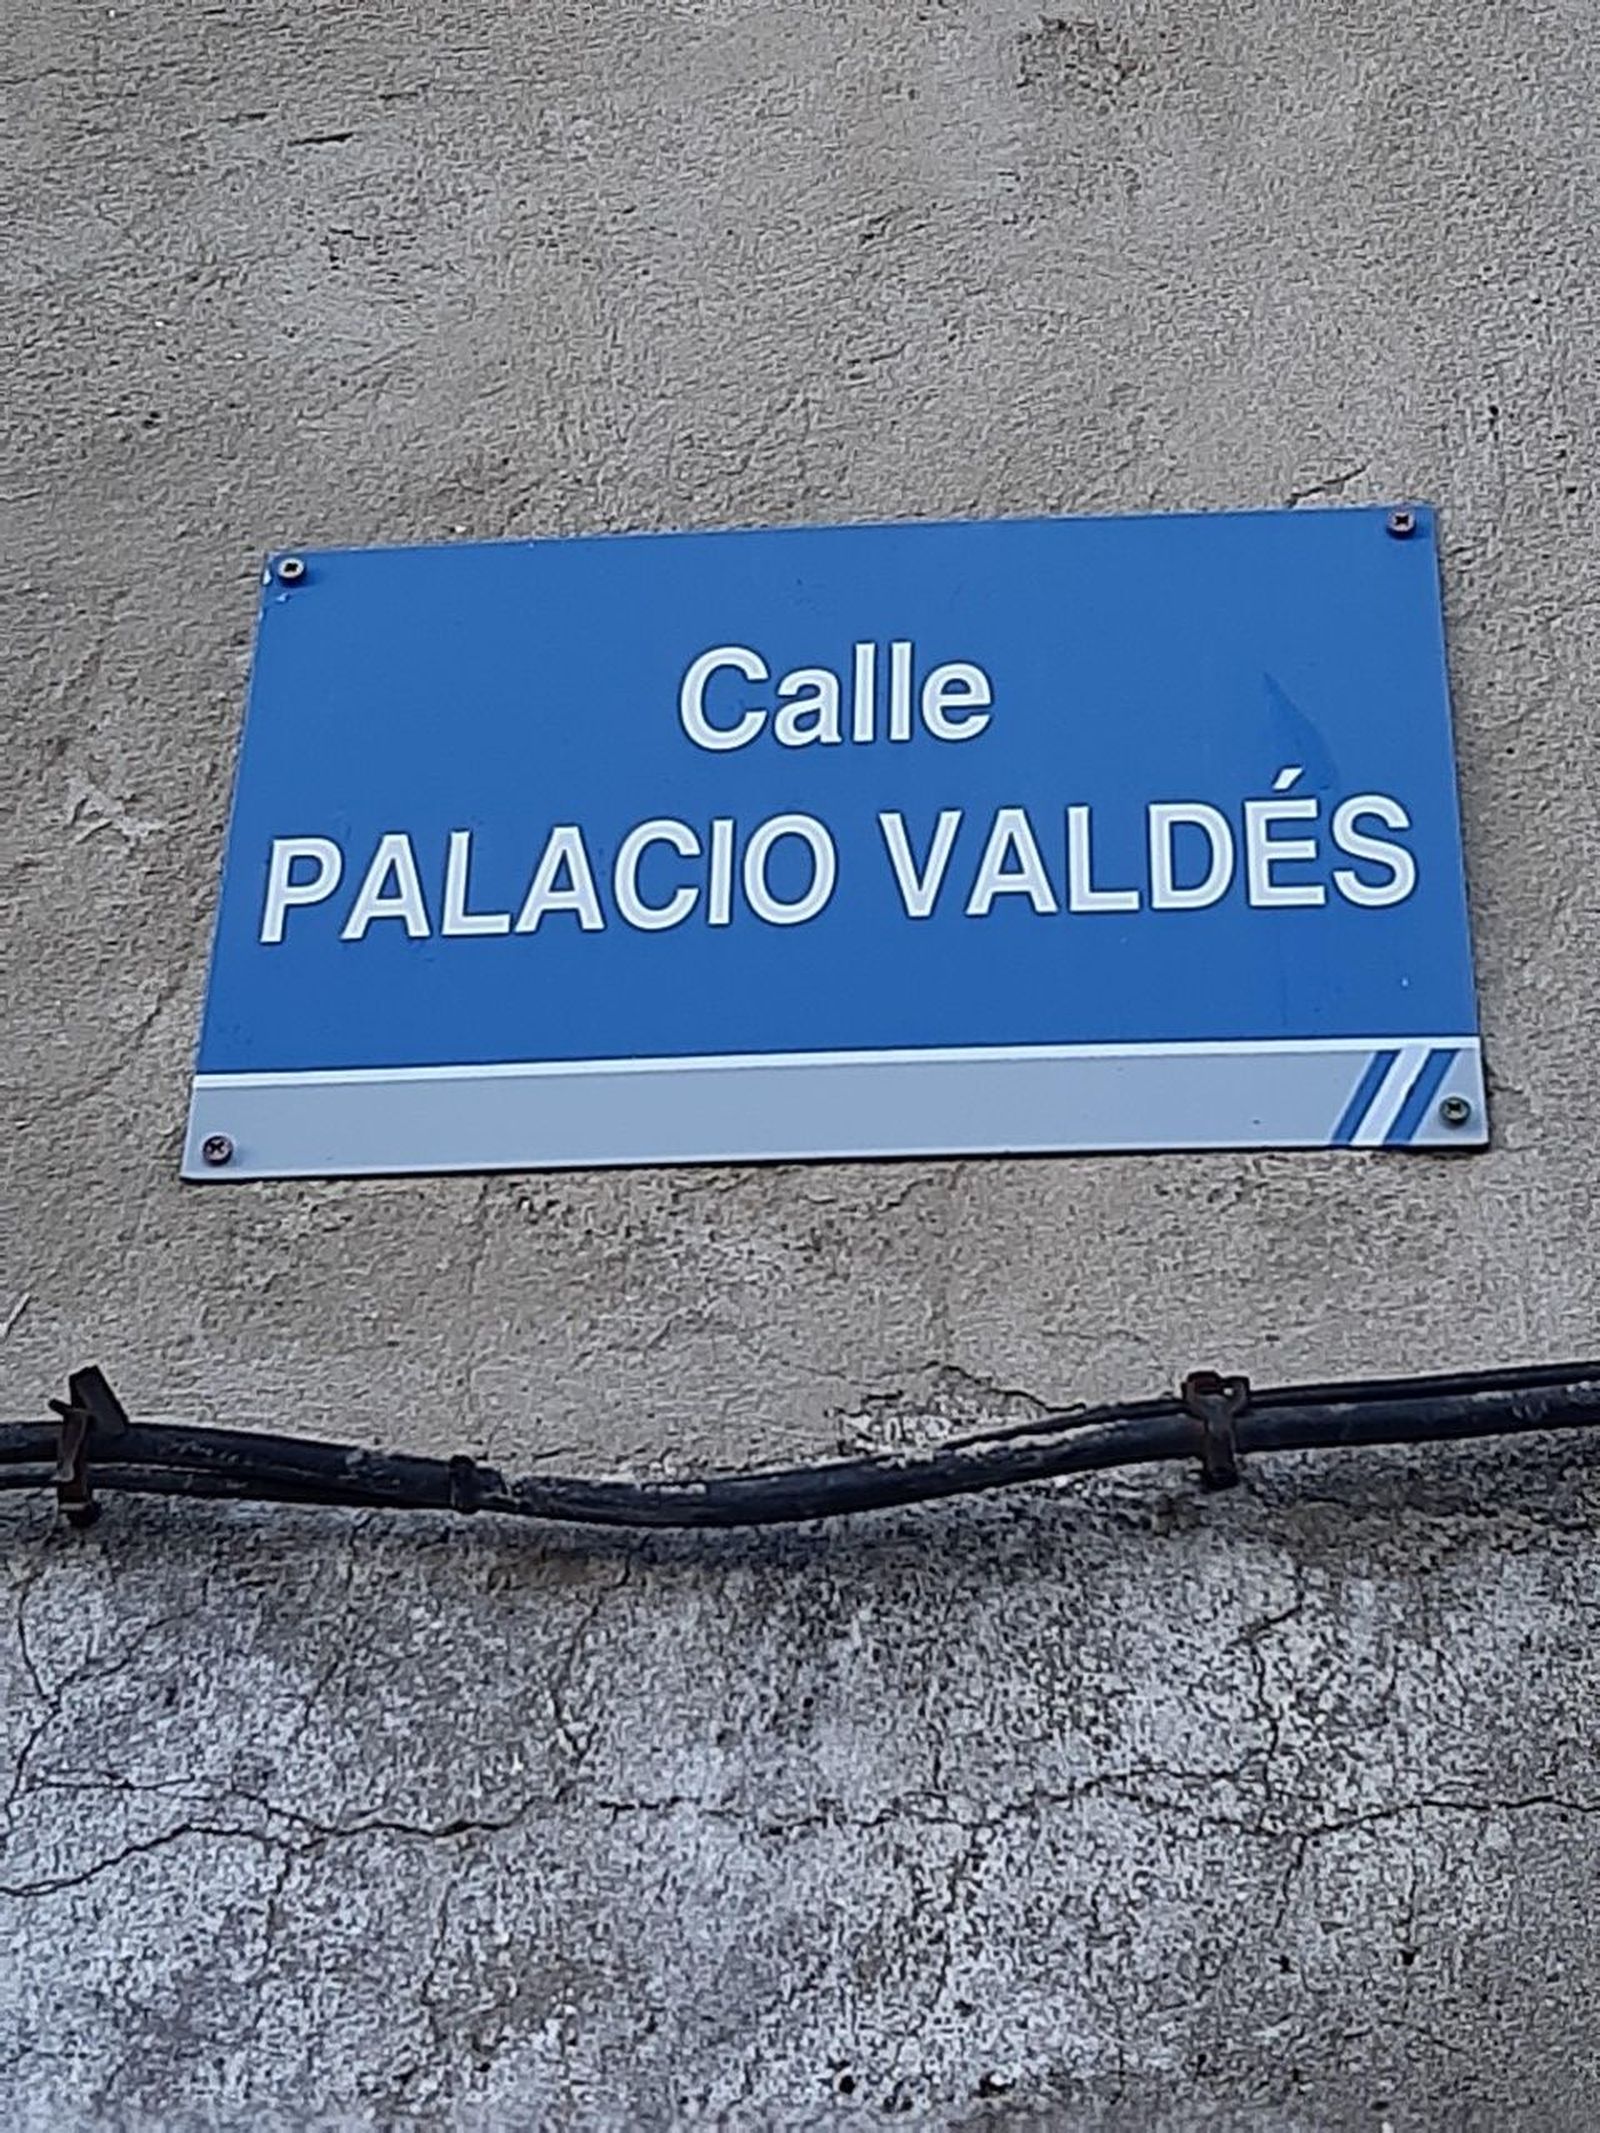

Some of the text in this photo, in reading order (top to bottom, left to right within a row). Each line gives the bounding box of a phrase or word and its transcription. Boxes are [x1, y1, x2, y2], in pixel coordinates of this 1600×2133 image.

[680, 642, 992, 751] Calle
[260, 768, 1417, 943] PALACIO VALDÉS
